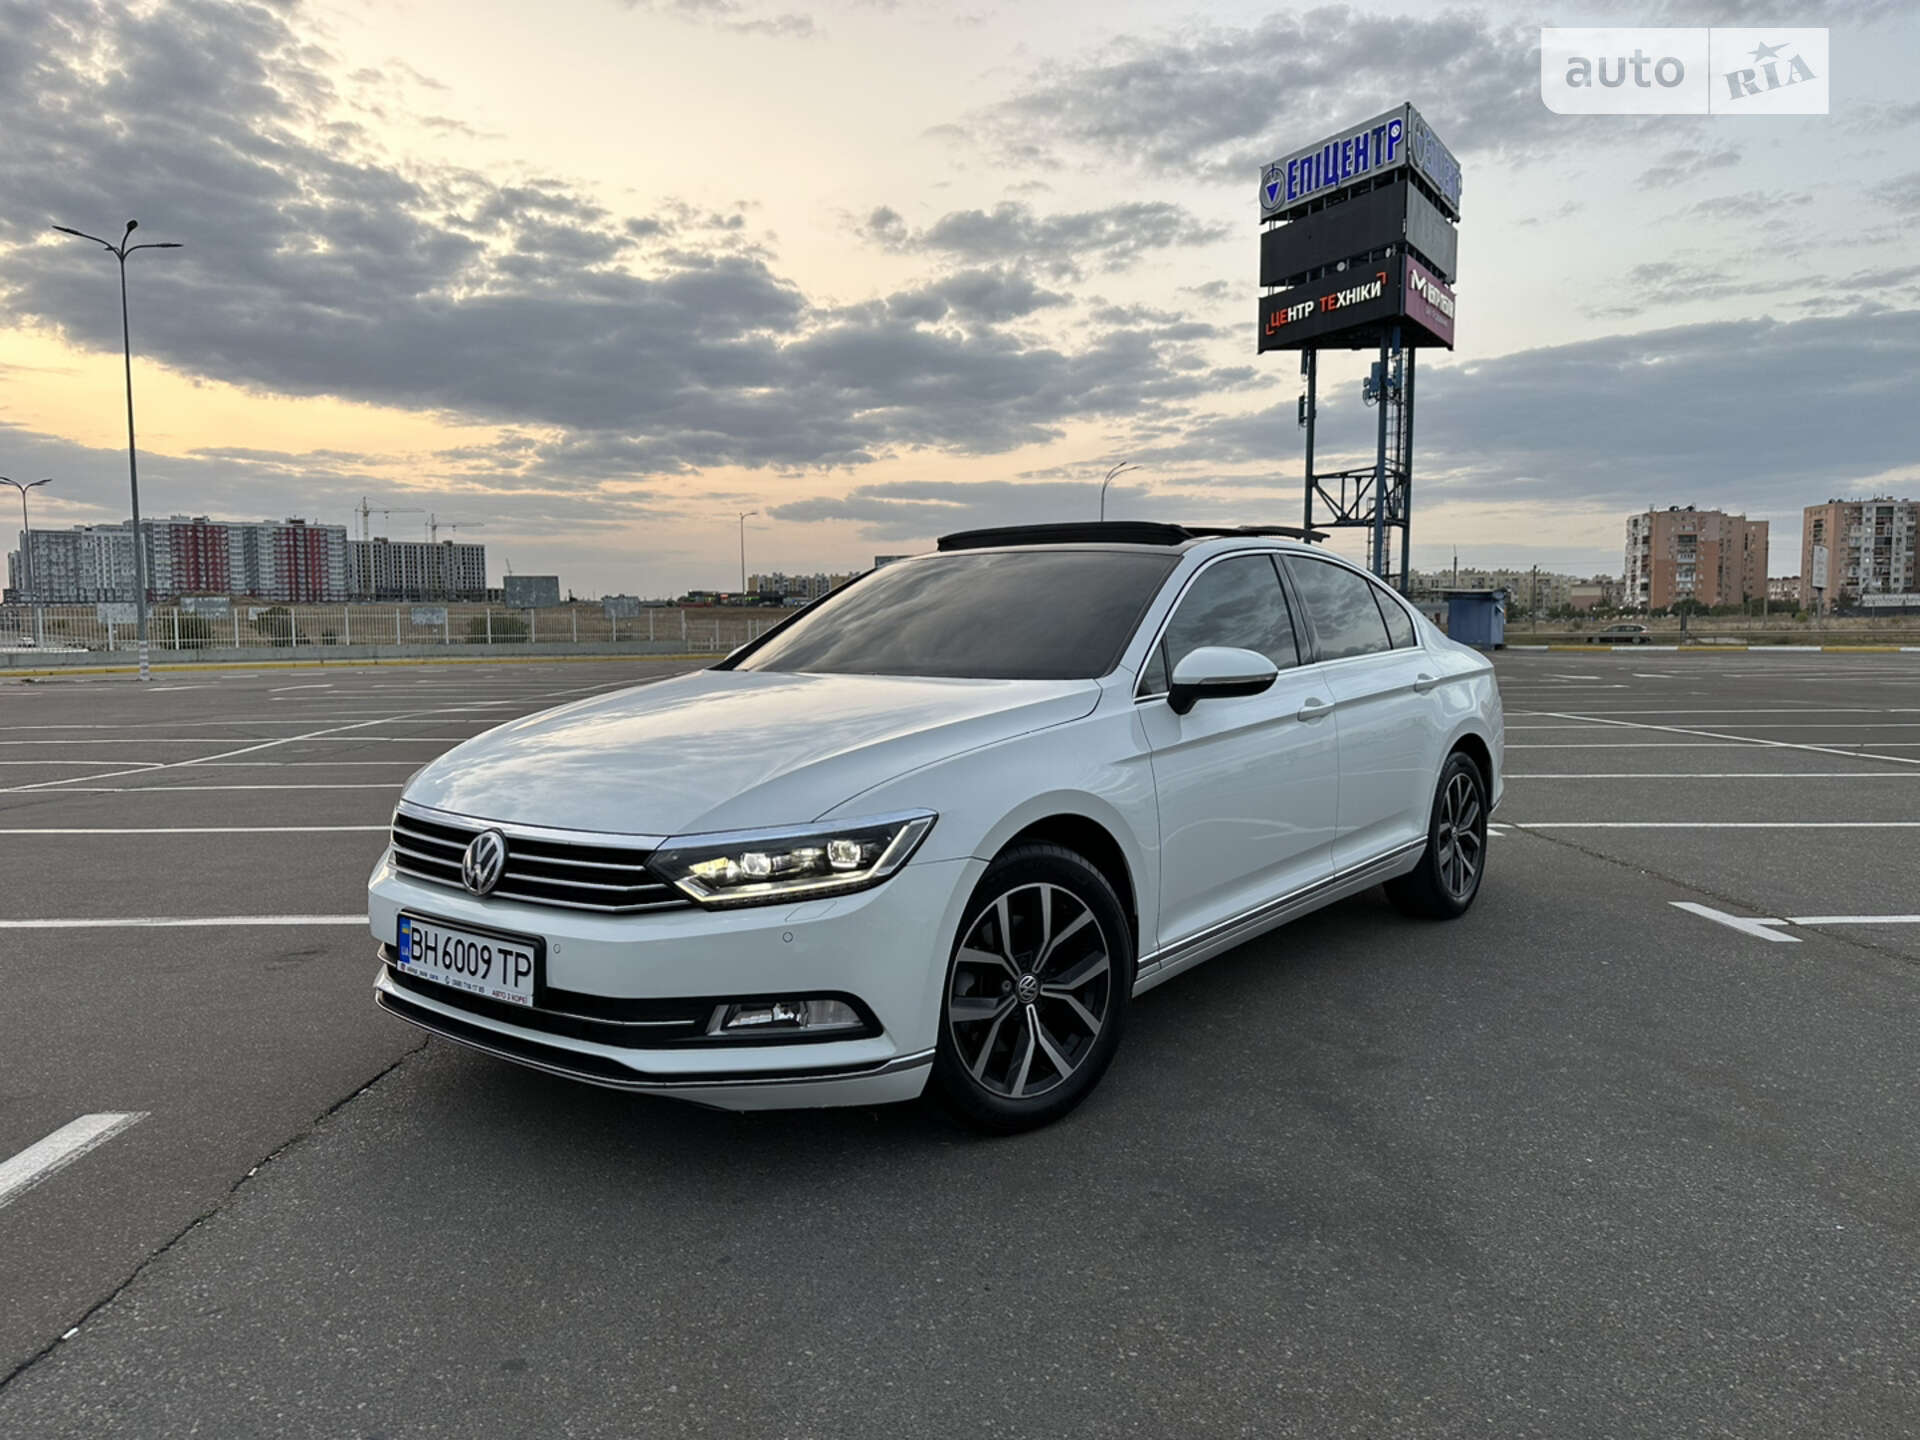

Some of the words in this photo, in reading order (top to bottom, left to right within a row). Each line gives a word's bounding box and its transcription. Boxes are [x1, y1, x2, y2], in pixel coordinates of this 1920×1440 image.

[1286, 118, 1404, 201] ЕПІЦЕНТР
[1271, 301, 1315, 328] ЦЕНТР
[1320, 280, 1381, 313] ТЕХНІКИ
[442, 936, 492, 980] 6009
